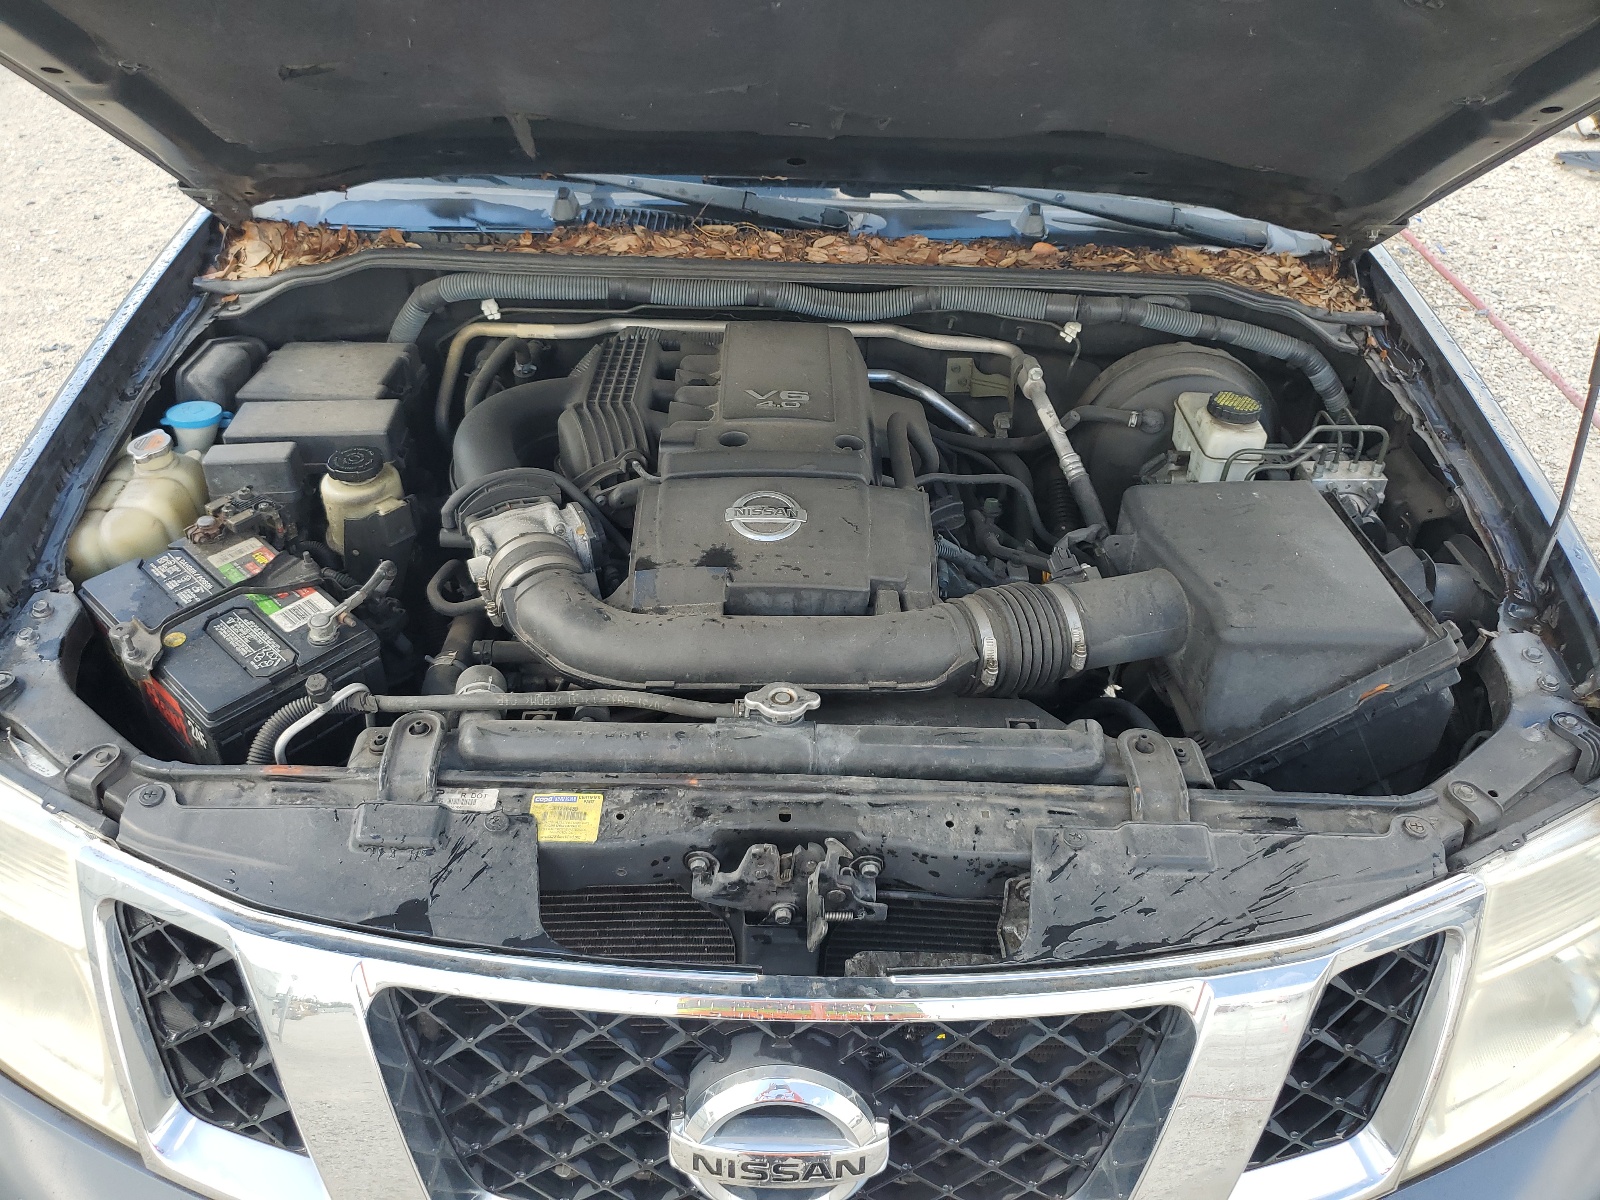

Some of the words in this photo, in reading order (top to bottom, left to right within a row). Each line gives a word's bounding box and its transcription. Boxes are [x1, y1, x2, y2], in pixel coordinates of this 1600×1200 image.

[744, 389, 810, 402] V6
[756, 400, 801, 409] 4.0
[733, 507, 799, 518] NISSAN
[691, 1152, 866, 1183] NISSAN
